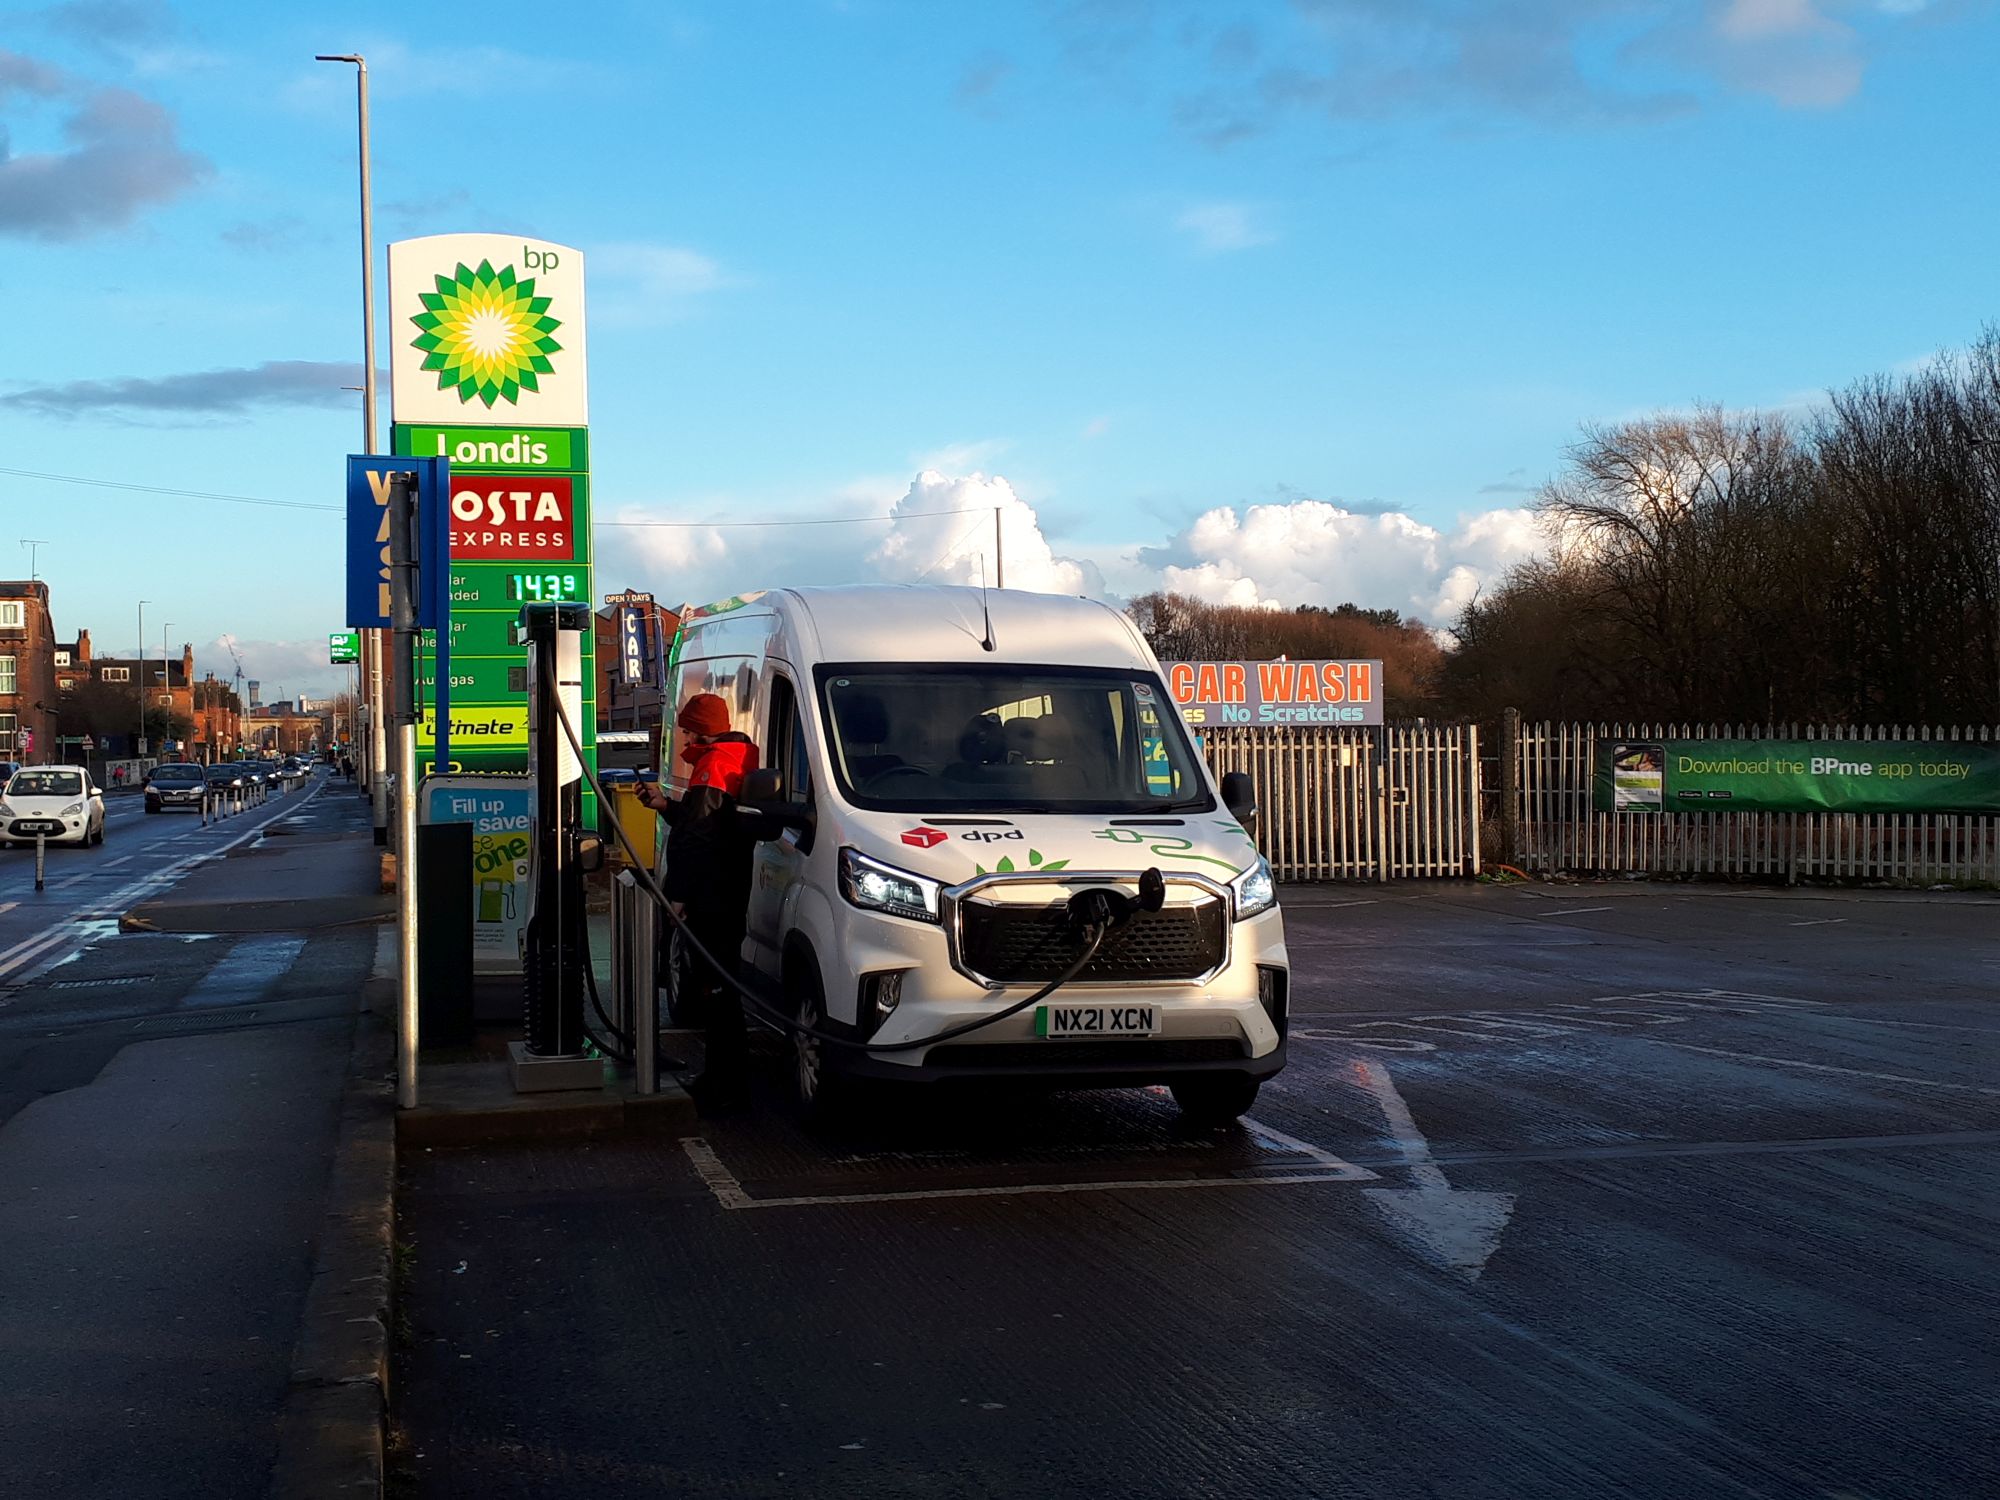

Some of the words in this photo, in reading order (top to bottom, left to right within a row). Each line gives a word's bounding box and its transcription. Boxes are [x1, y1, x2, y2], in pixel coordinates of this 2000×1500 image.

[523, 245, 560, 275] bp
[437, 433, 549, 465] Londis
[451, 490, 563, 526] OSTA
[605, 595, 625, 604] OPEN
[631, 593, 651, 603] DAYS
[626, 613, 641, 678] CAR
[1170, 664, 1246, 704] CAR
[1257, 663, 1372, 704] WASH
[1221, 704, 1251, 723] No
[1258, 704, 1364, 723] Scratches
[1678, 756, 1769, 774] Download
[1776, 759, 1804, 774] the
[1810, 757, 1872, 776] BPme
[1879, 762, 1913, 779] app
[1920, 759, 1971, 780] today
[452, 798, 477, 815] Fill
[481, 800, 505, 816] up
[478, 814, 529, 832] save
[961, 829, 1025, 843] dpd
[474, 837, 529, 873] one
[1054, 1009, 1104, 1031] NX21
[1110, 1008, 1153, 1030] XCN
